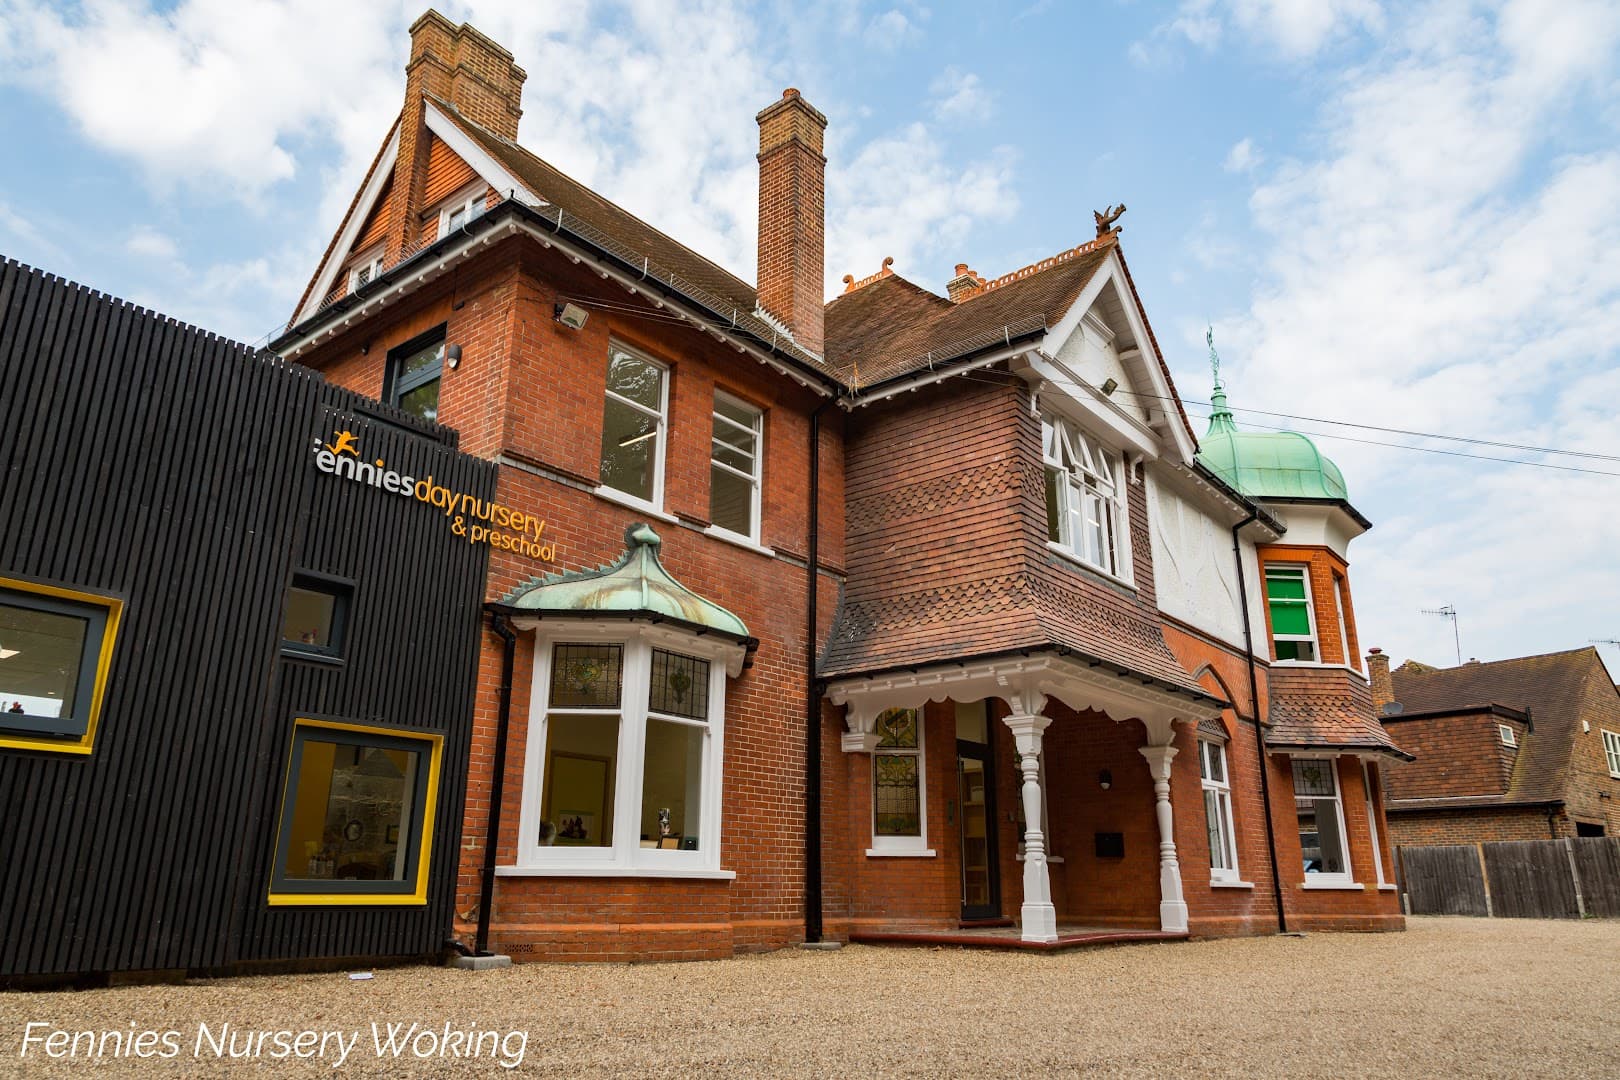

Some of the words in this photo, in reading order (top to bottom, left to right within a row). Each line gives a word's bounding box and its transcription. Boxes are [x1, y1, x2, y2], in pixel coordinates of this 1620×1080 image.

[451, 515, 467, 538] &
[470, 524, 556, 563] preschool
[461, 493, 546, 543] nursery
